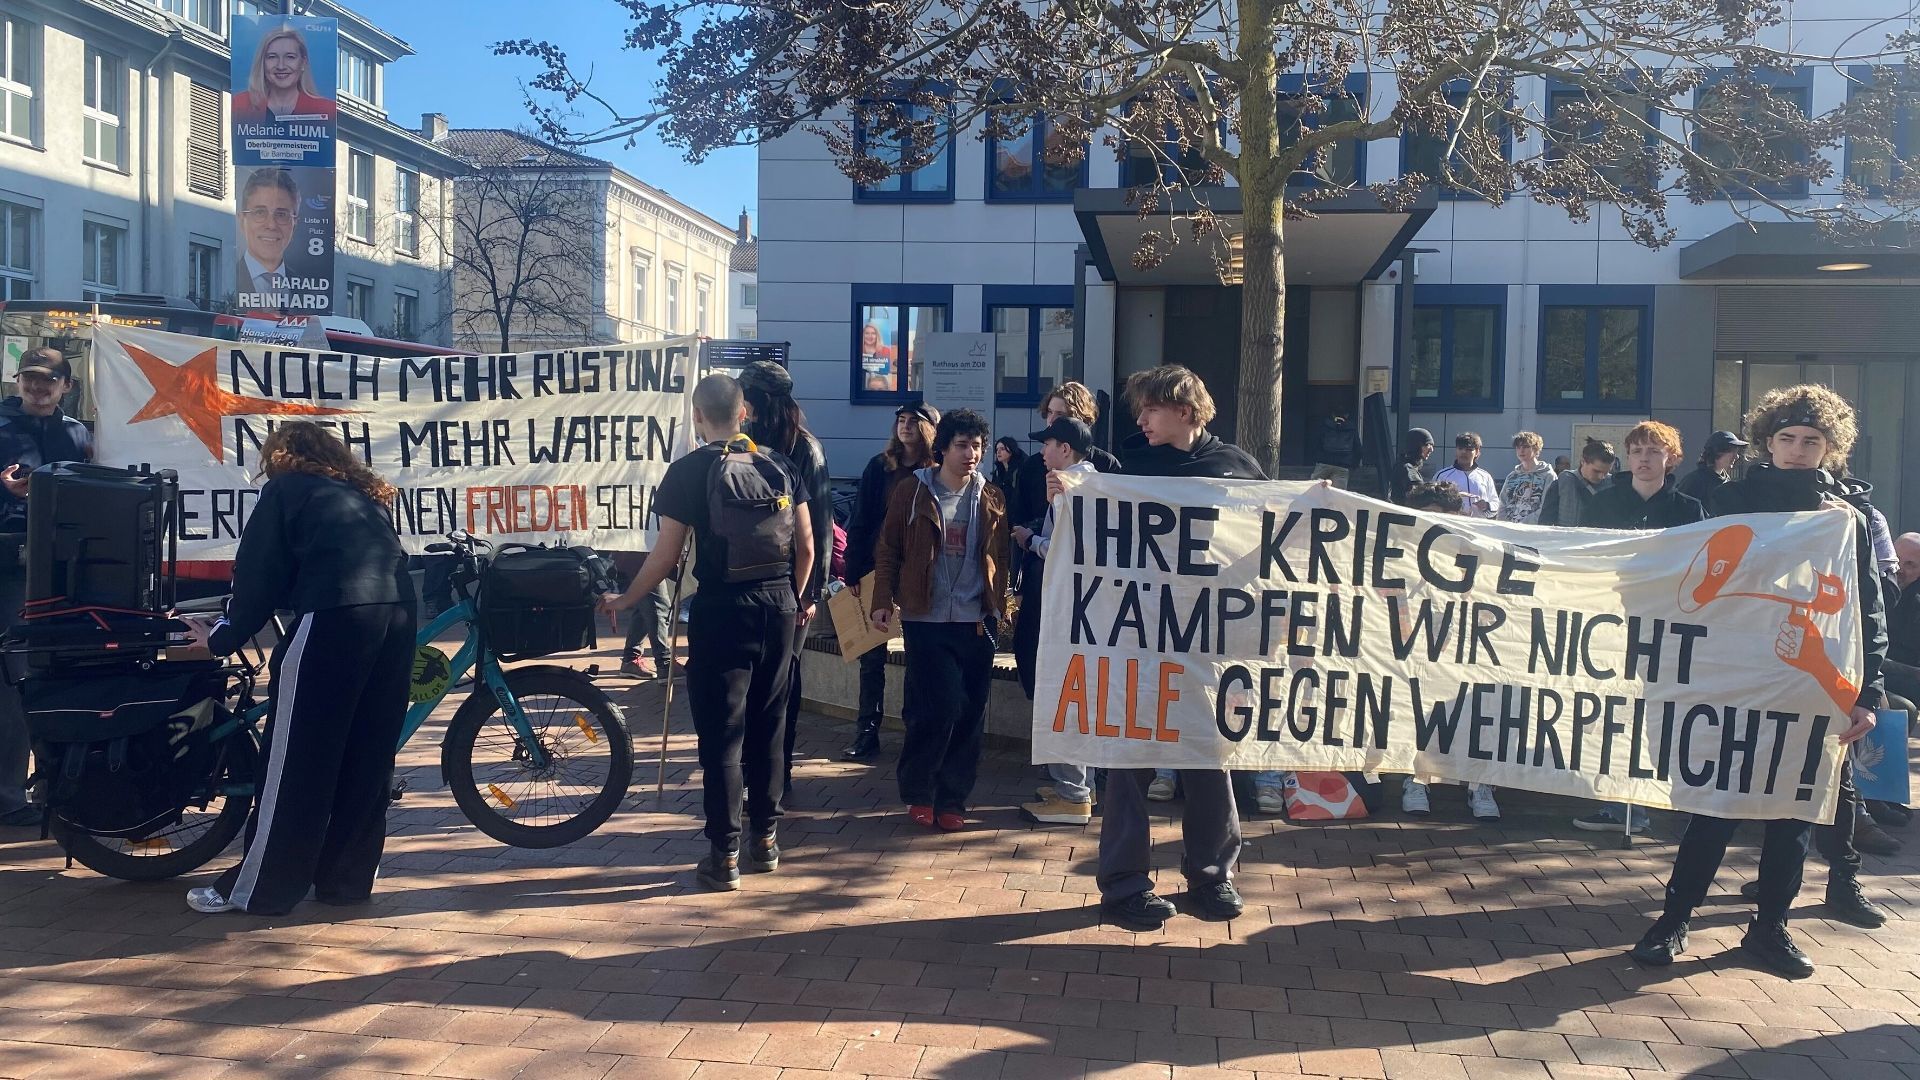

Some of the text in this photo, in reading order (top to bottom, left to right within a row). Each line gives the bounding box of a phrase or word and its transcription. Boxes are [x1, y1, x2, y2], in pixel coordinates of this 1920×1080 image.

[237, 124, 330, 139] Melanie HUML
[247, 141, 317, 150] Oberbürgermeisterin
[271, 151, 303, 159] Bamberg
[307, 237, 324, 256] 8
[272, 276, 330, 291] HARALD
[238, 292, 329, 309] REINHARD
[242, 327, 299, 340] Hans-Jürgen
[932, 360, 959, 368] Rathaus
[230, 346, 689, 402] NOCH MEHR RÜSTUNG
[234, 415, 677, 467] NH MEHR WAFFEN
[465, 484, 588, 535] FRIEDEN
[1073, 495, 1541, 597] IHRE KRIEGE
[1070, 572, 1708, 684] KÄMPFEN WIR NICHT
[1052, 653, 1831, 802] ALLE GEGEN WEHRPFLICHT!
